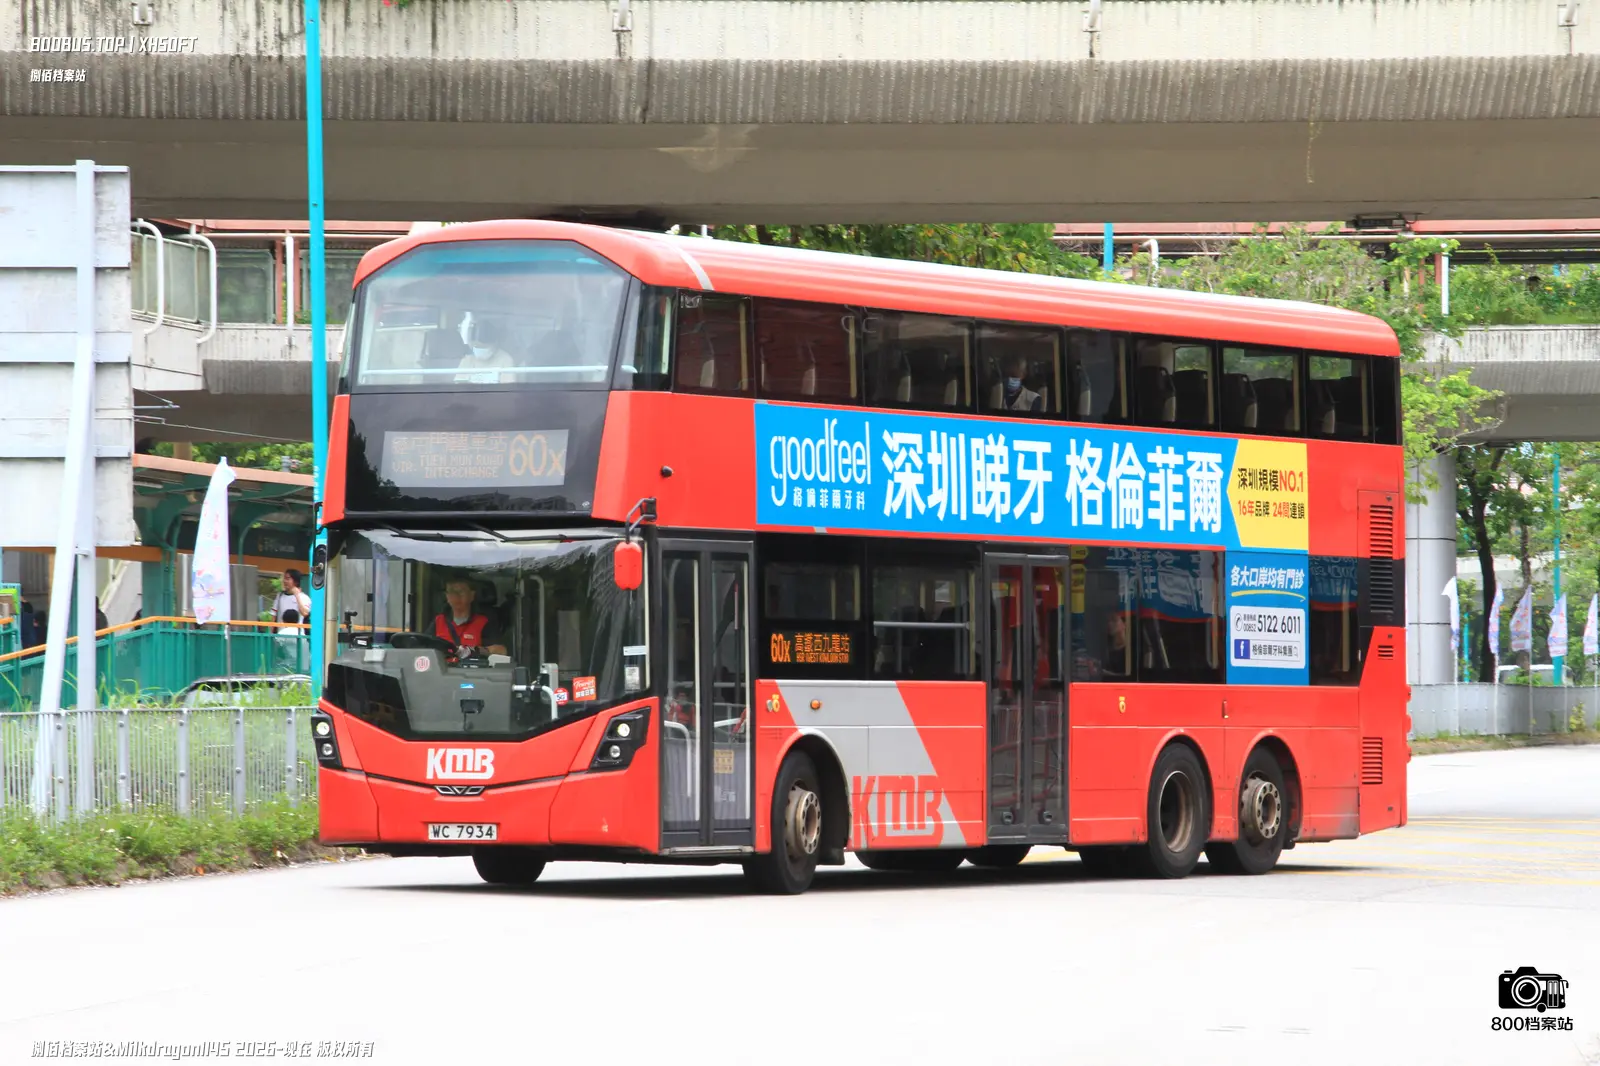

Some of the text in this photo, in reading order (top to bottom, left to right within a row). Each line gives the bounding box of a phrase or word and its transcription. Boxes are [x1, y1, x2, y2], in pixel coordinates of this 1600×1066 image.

[770, 418, 872, 506] goodfeel
[882, 429, 1224, 534] 深圳睇牙 格倫菲爾
[792, 486, 865, 511] 格倫菲爾牙科
[1231, 564, 1305, 590] 各大口岸均有門診
[1257, 614, 1278, 633] 5122
[1281, 615, 1301, 634] 6011
[426, 748, 495, 779] KMB
[851, 775, 944, 848] KMB
[432, 825, 494, 839] WC 7934
